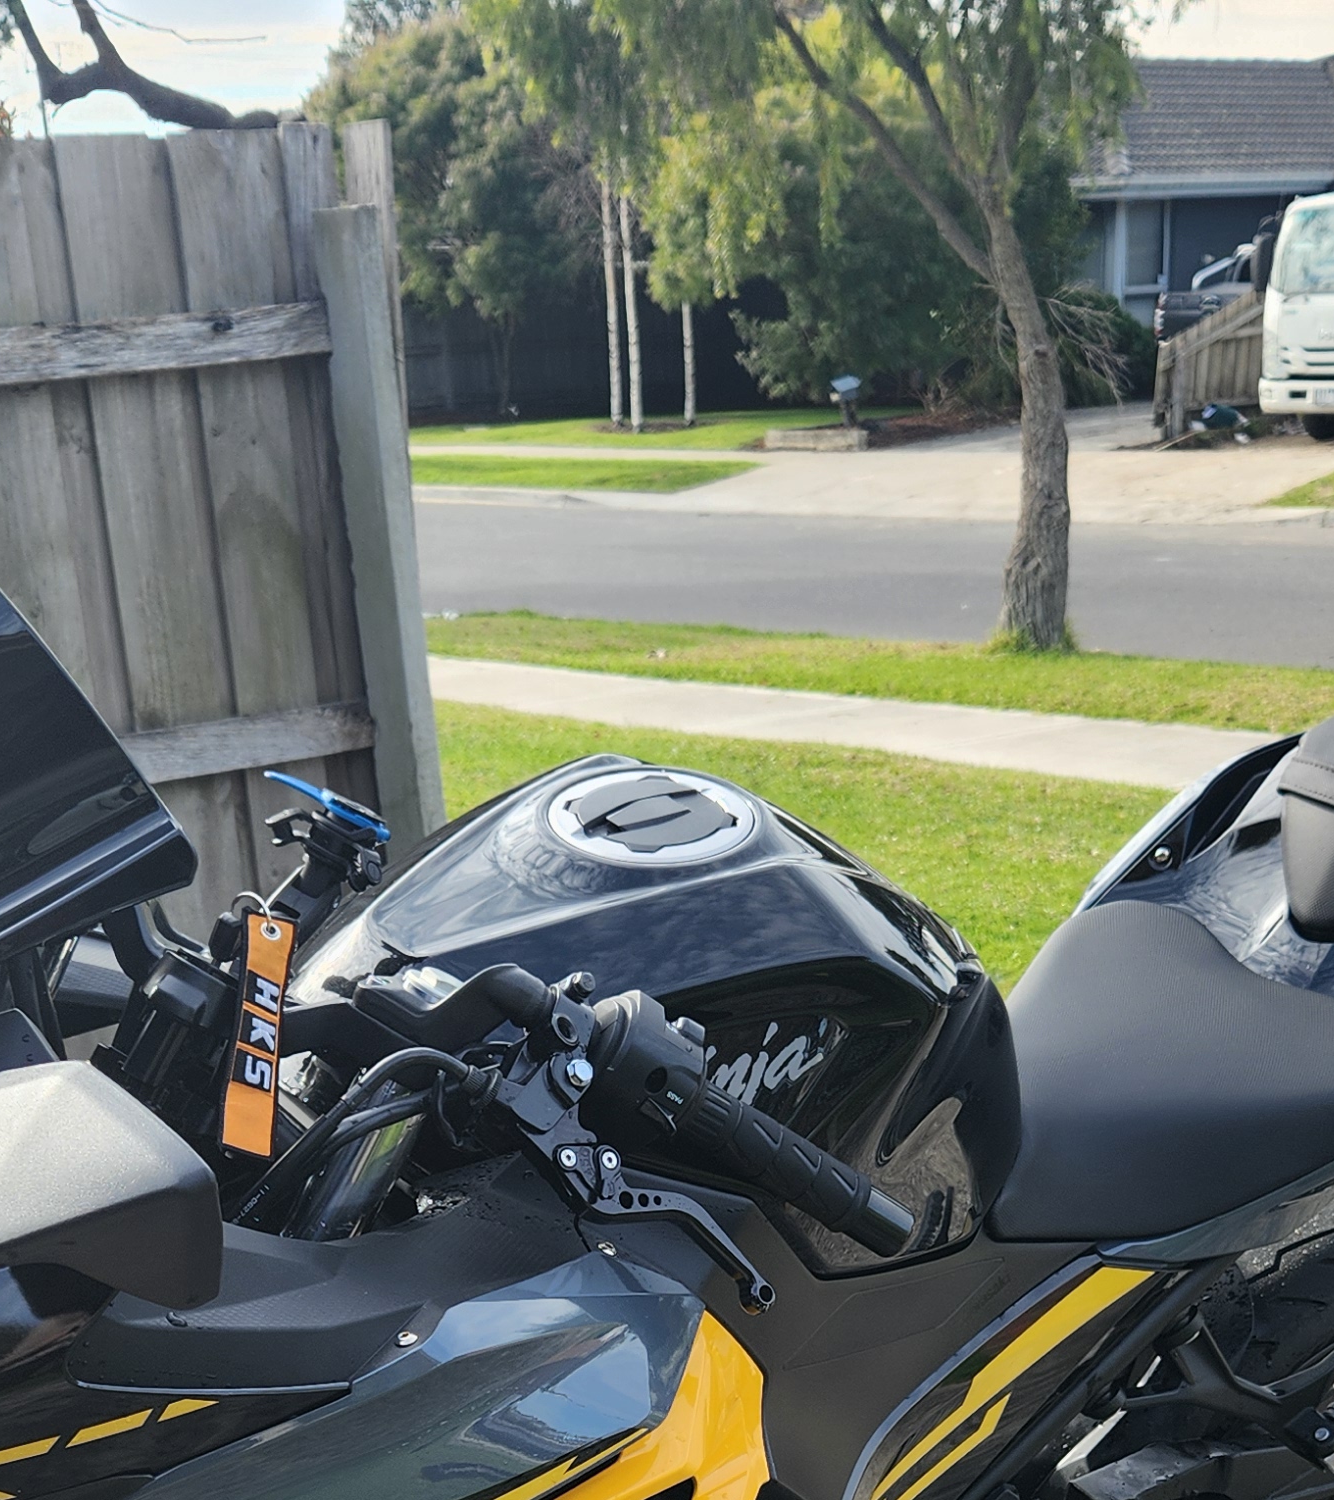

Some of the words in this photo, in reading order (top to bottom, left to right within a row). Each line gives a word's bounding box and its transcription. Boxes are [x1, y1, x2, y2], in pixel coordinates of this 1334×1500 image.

[244, 977, 280, 1091] HKS
[705, 1021, 824, 1106] nja
[666, 1090, 684, 1105] PASS
